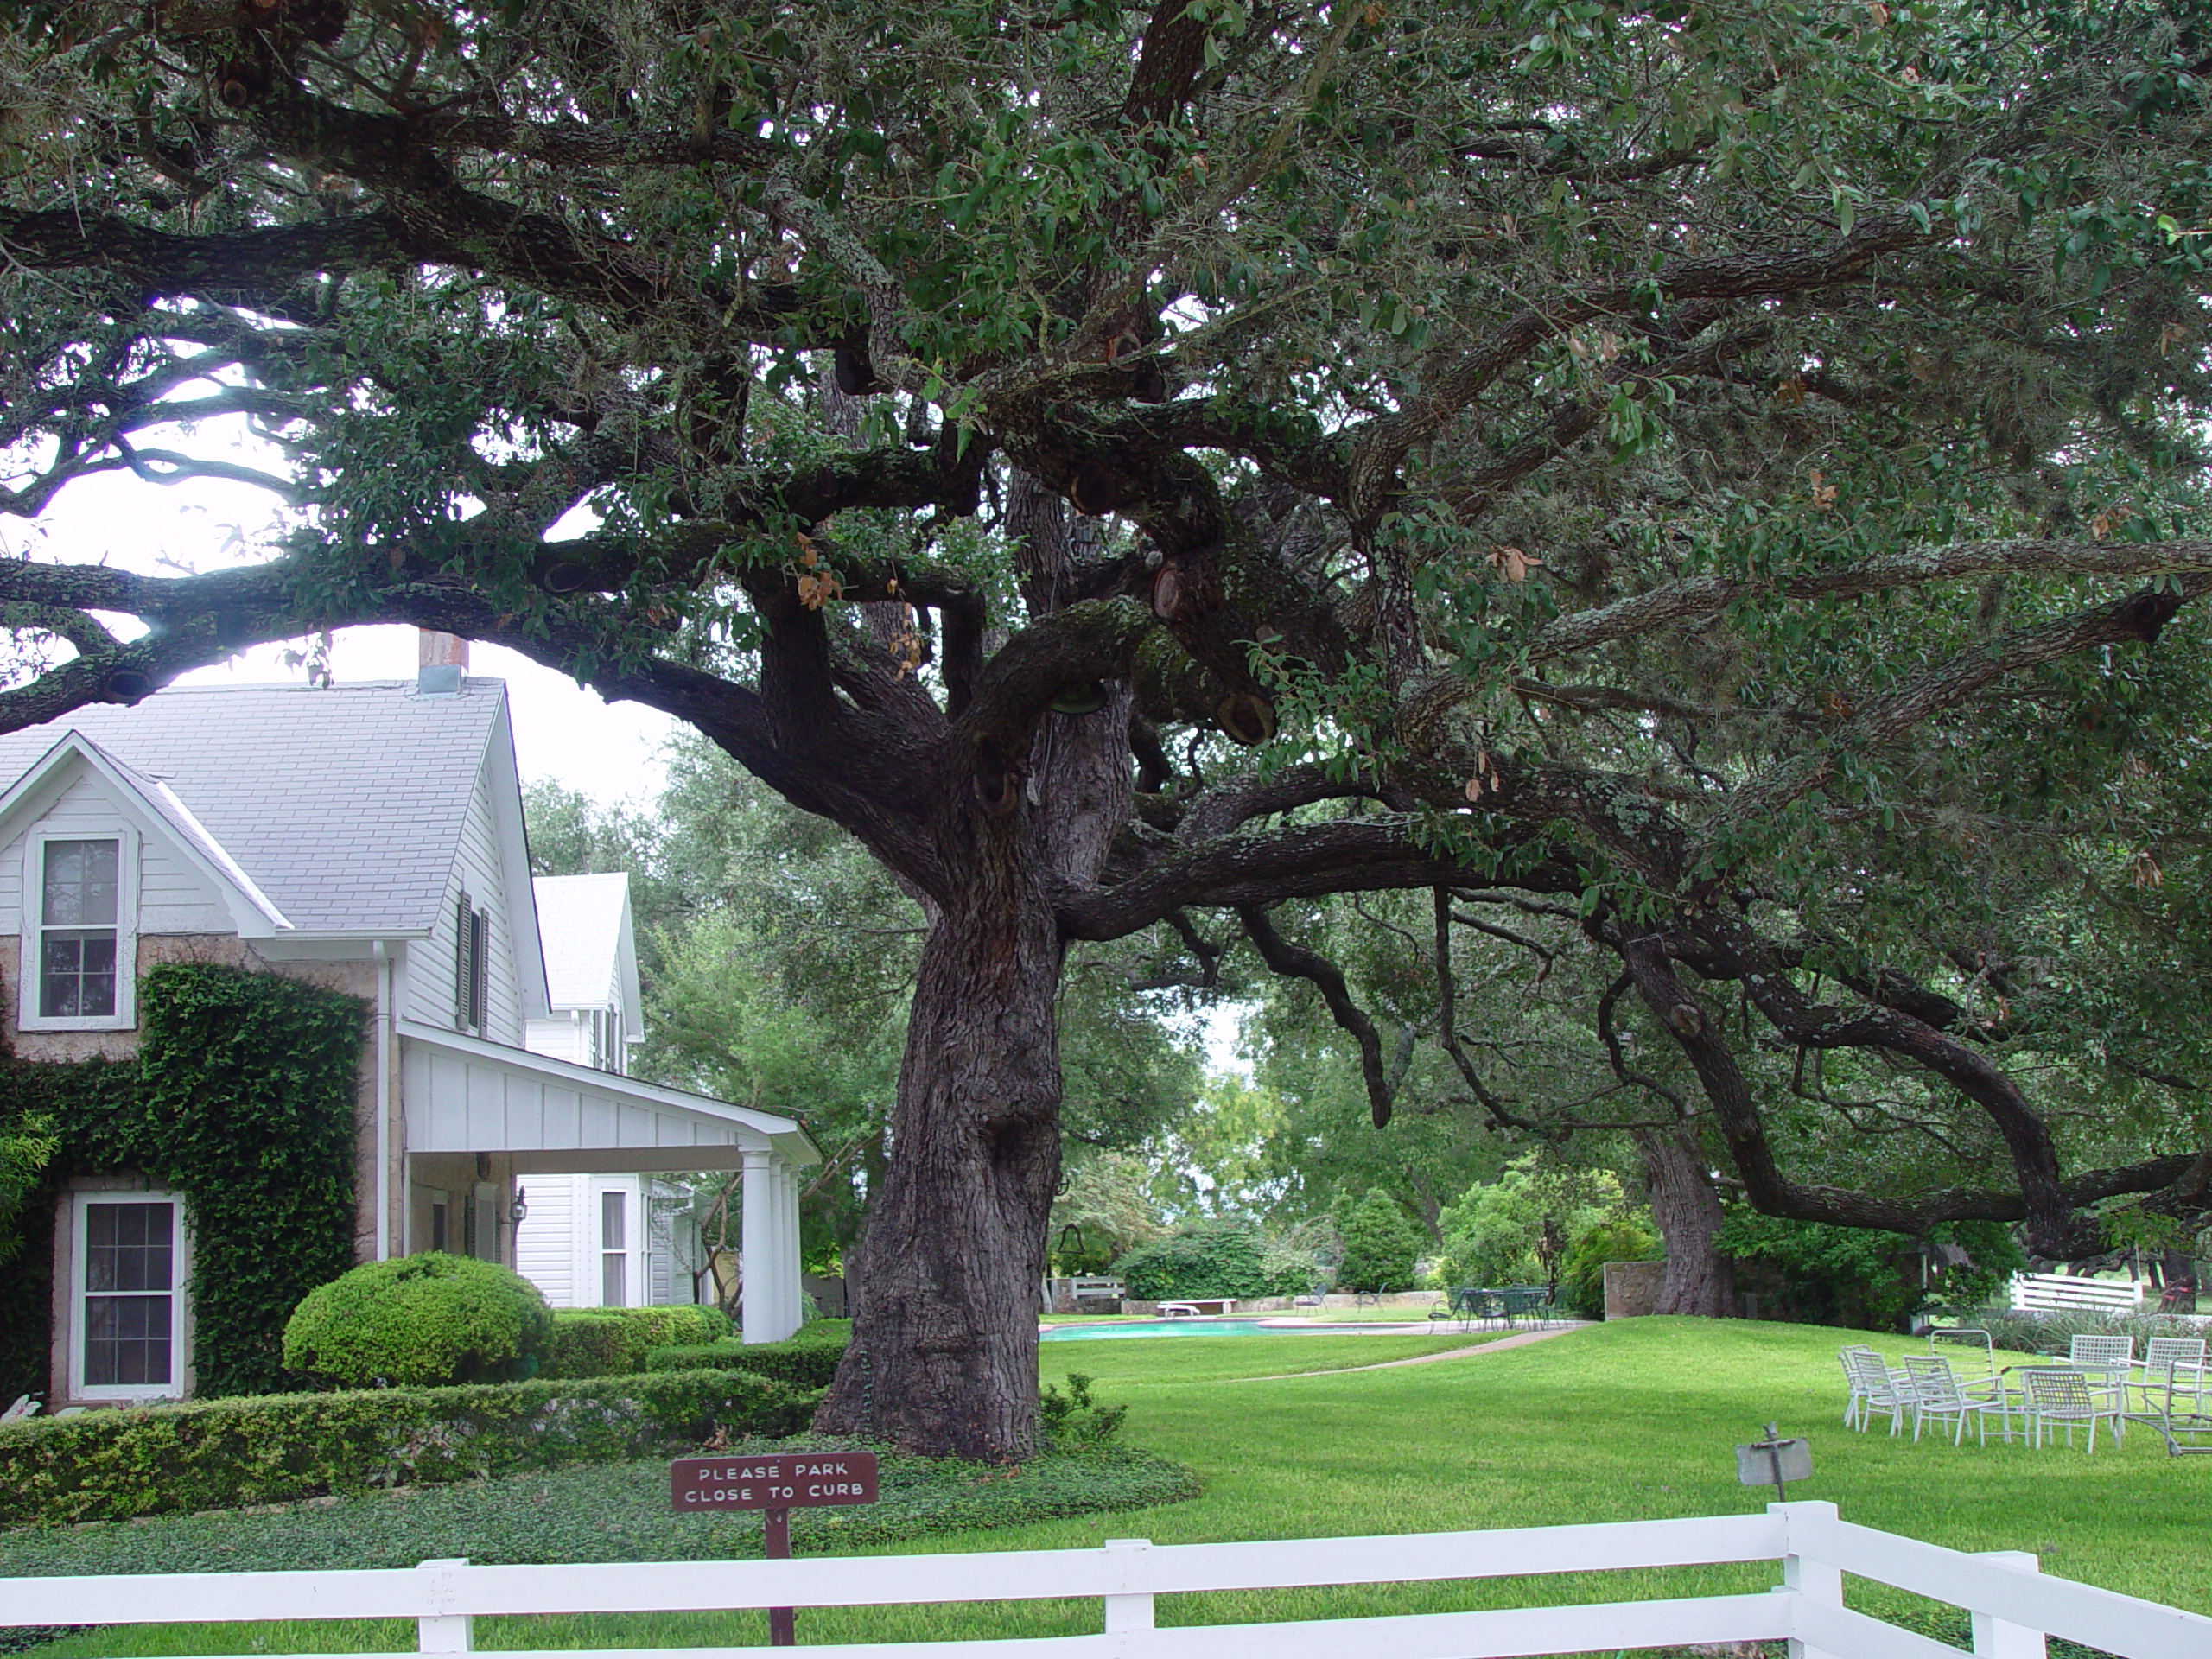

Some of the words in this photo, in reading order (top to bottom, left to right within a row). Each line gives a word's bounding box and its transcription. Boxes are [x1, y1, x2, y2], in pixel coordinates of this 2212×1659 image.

[699, 1466, 780, 1481] PLEASE
[795, 1463, 849, 1477] PARK
[684, 1488, 753, 1503] CLOSE
[769, 1486, 794, 1499] TO
[808, 1484, 863, 1497] CURB
